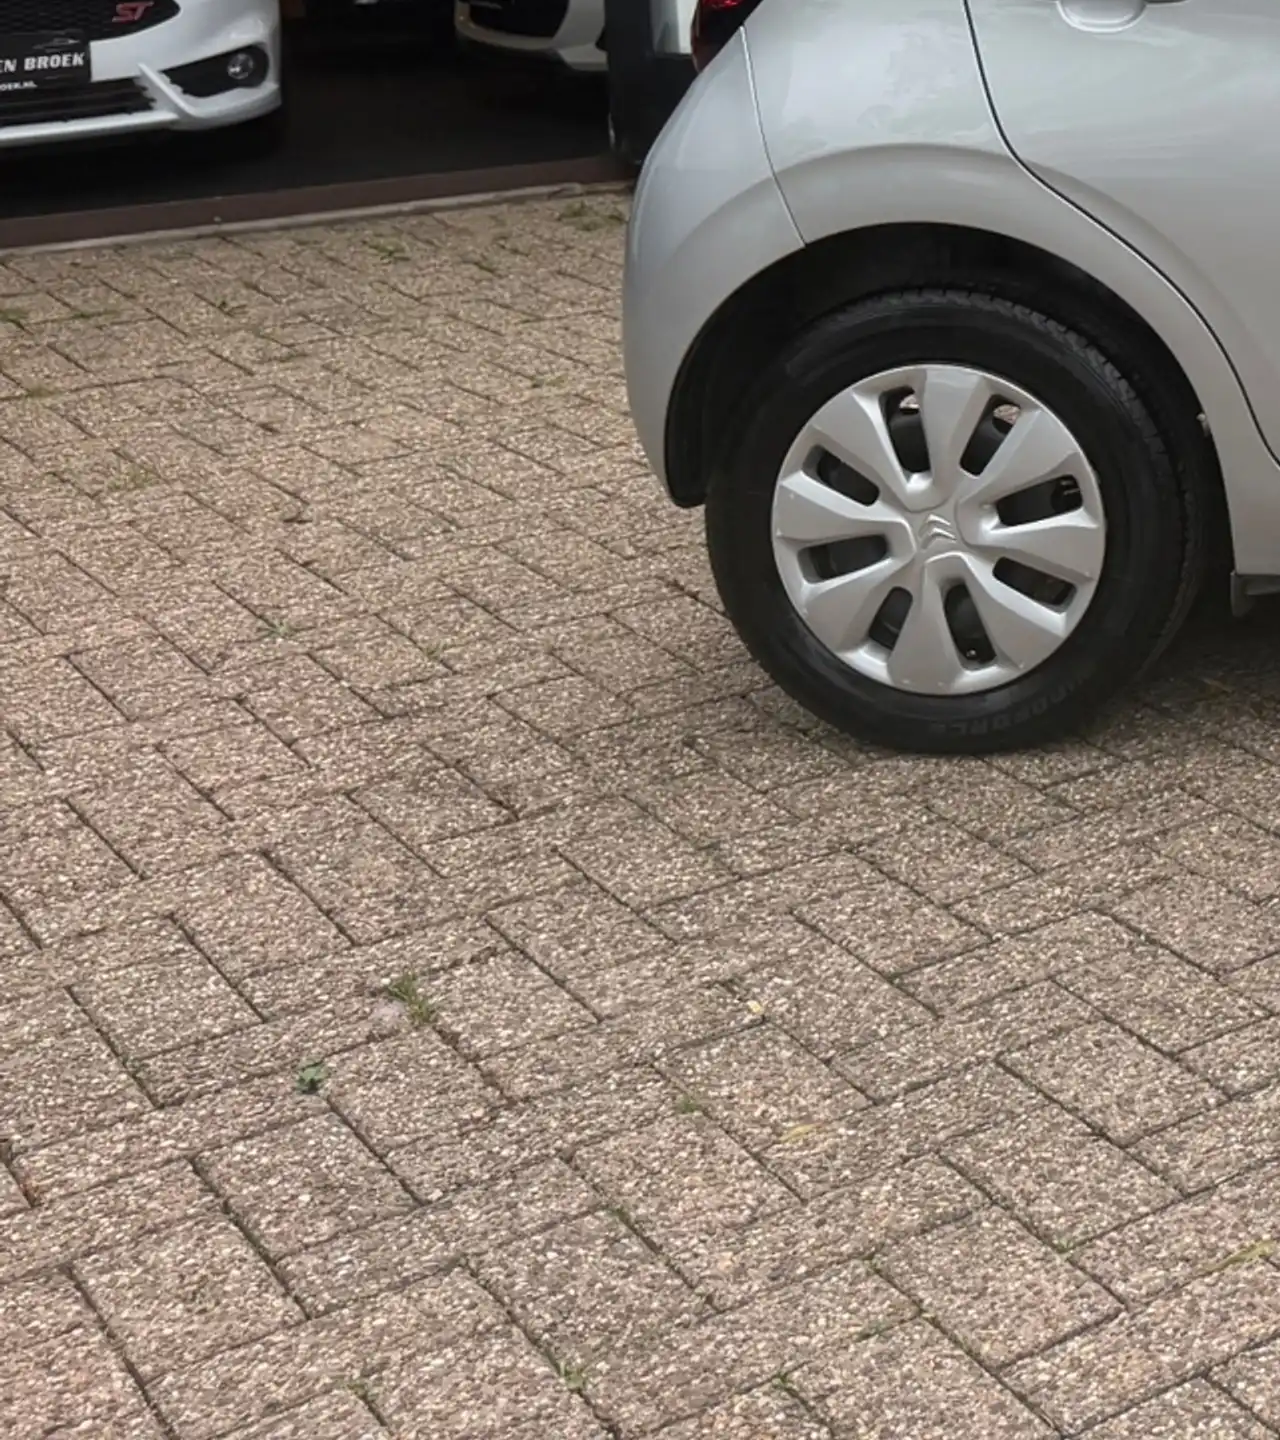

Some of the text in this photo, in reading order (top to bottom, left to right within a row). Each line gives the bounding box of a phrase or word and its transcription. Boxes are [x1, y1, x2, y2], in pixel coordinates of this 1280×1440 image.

[112, 1, 154, 22] ST
[0, 52, 85, 73] N BROEK
